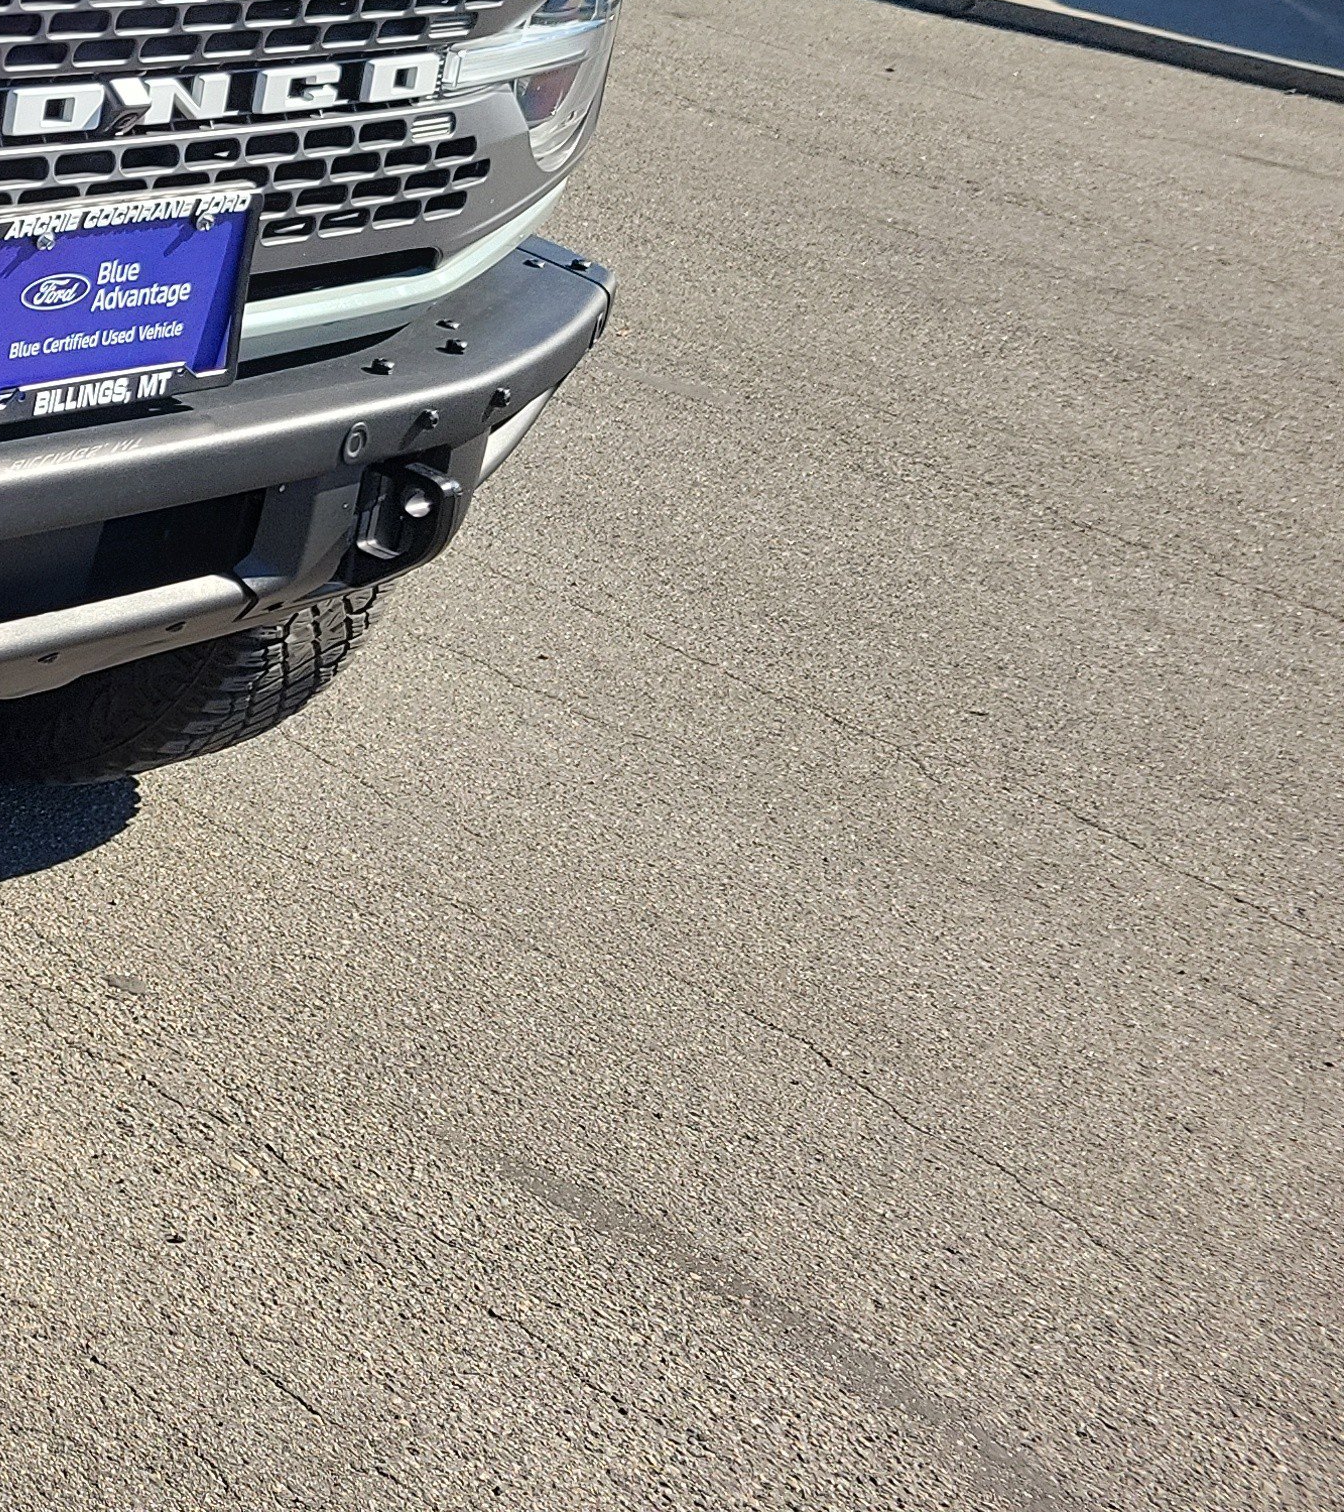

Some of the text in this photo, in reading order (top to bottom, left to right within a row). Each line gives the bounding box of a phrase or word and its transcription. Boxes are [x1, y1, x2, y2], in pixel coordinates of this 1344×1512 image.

[4, 192, 252, 241] ARCHIE COCHRANE FORD
[97, 259, 141, 286] Blue
[32, 277, 79, 306] Ford
[90, 279, 192, 312] Advantage
[8, 320, 185, 360] Blue Certified Used Vehicle
[32, 371, 173, 417] BILLINGS, MT
